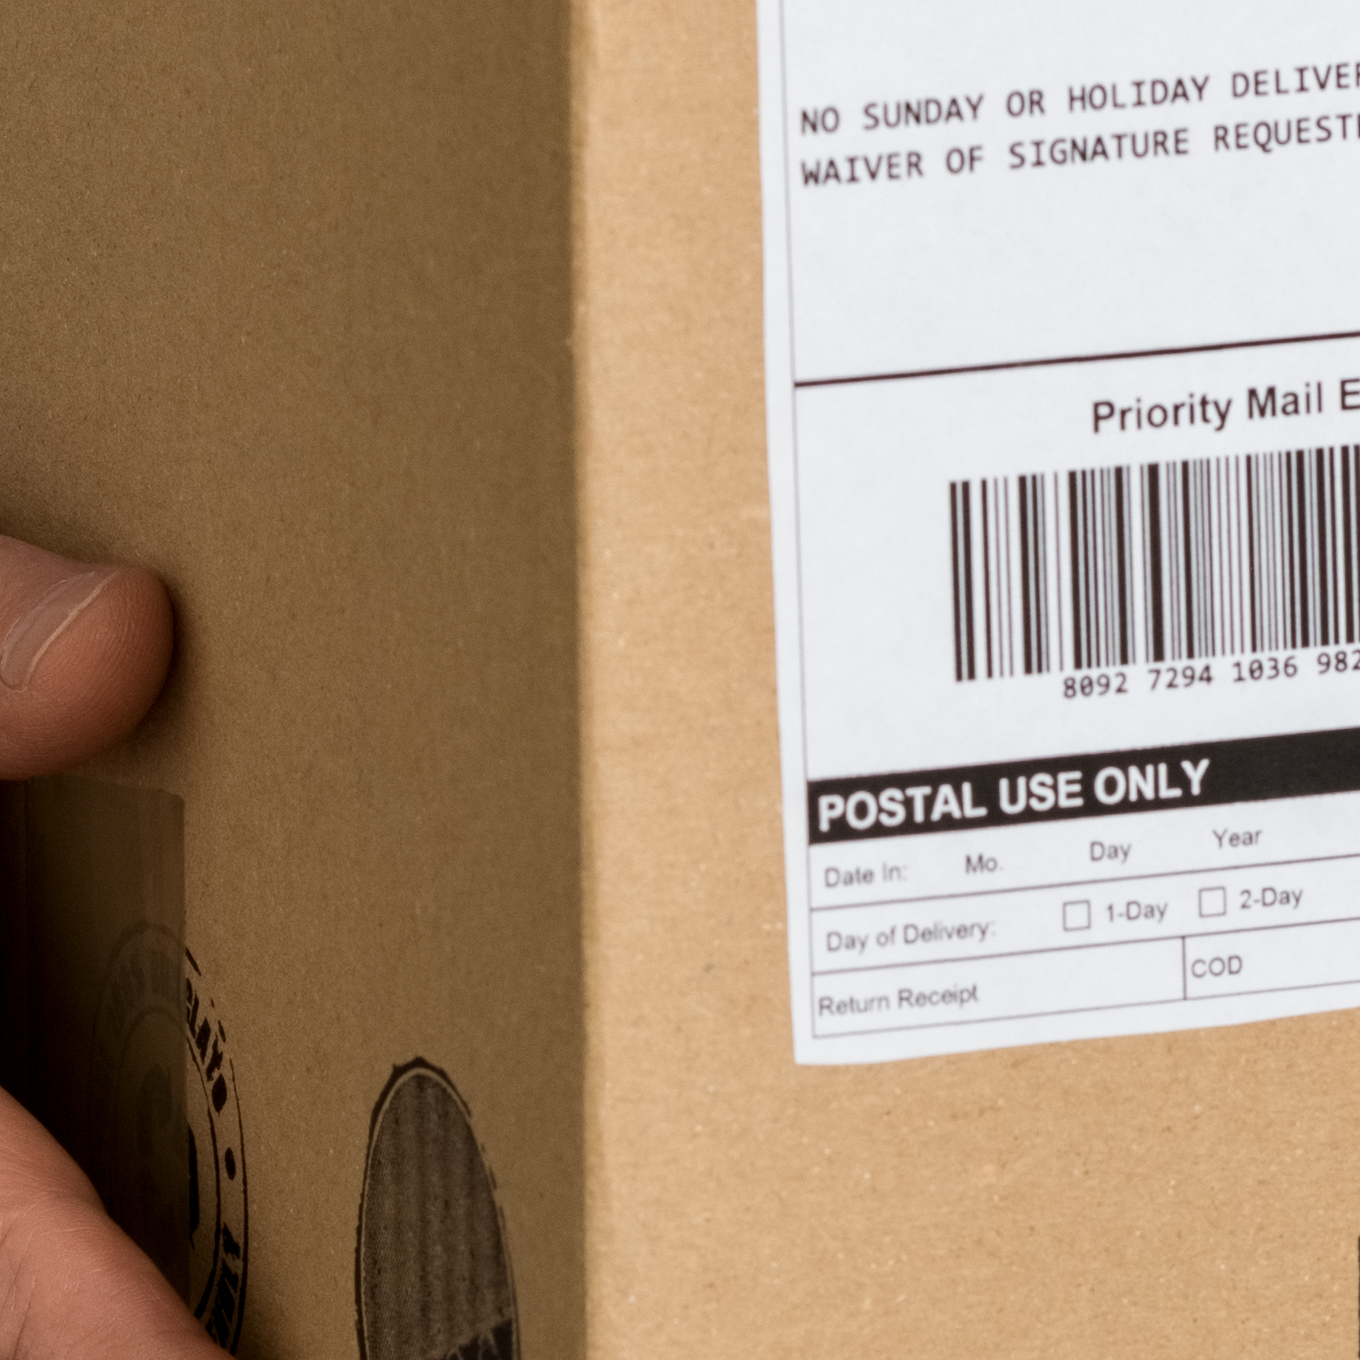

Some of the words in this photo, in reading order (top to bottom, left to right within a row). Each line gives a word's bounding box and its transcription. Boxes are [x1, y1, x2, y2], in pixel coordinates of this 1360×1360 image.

[801, 106, 840, 134] NO
[863, 95, 984, 130] SUNDAY
[1006, 89, 1045, 118] OR
[1068, 75, 1209, 112] HOLIDAY
[801, 151, 923, 187] WAIVER
[945, 145, 982, 175] OF
[1009, 128, 1188, 170] SIGNATURE
[1092, 393, 1232, 434] Priority
[1247, 381, 1323, 420] Mail
[1063, 668, 1128, 699] 8092
[1148, 660, 1213, 690] 7294
[1233, 655, 1298, 683] 1036
[817, 781, 989, 834] POSTAL
[998, 770, 1086, 815] USE
[1094, 758, 1211, 807] ONLY
[1089, 840, 1131, 863] Day
[1212, 829, 1262, 848] Year
[824, 866, 875, 889] Date
[883, 863, 907, 882] In:
[965, 853, 1003, 874] Mo.
[1106, 900, 1168, 923] 1-Day
[1240, 886, 1303, 910] 2-Day
[826, 930, 869, 953] Day
[875, 925, 897, 948] of
[903, 923, 996, 946] Delivery:
[1190, 954, 1243, 979] COD
[818, 989, 890, 1016] Return
[899, 984, 980, 1008] Receipt
